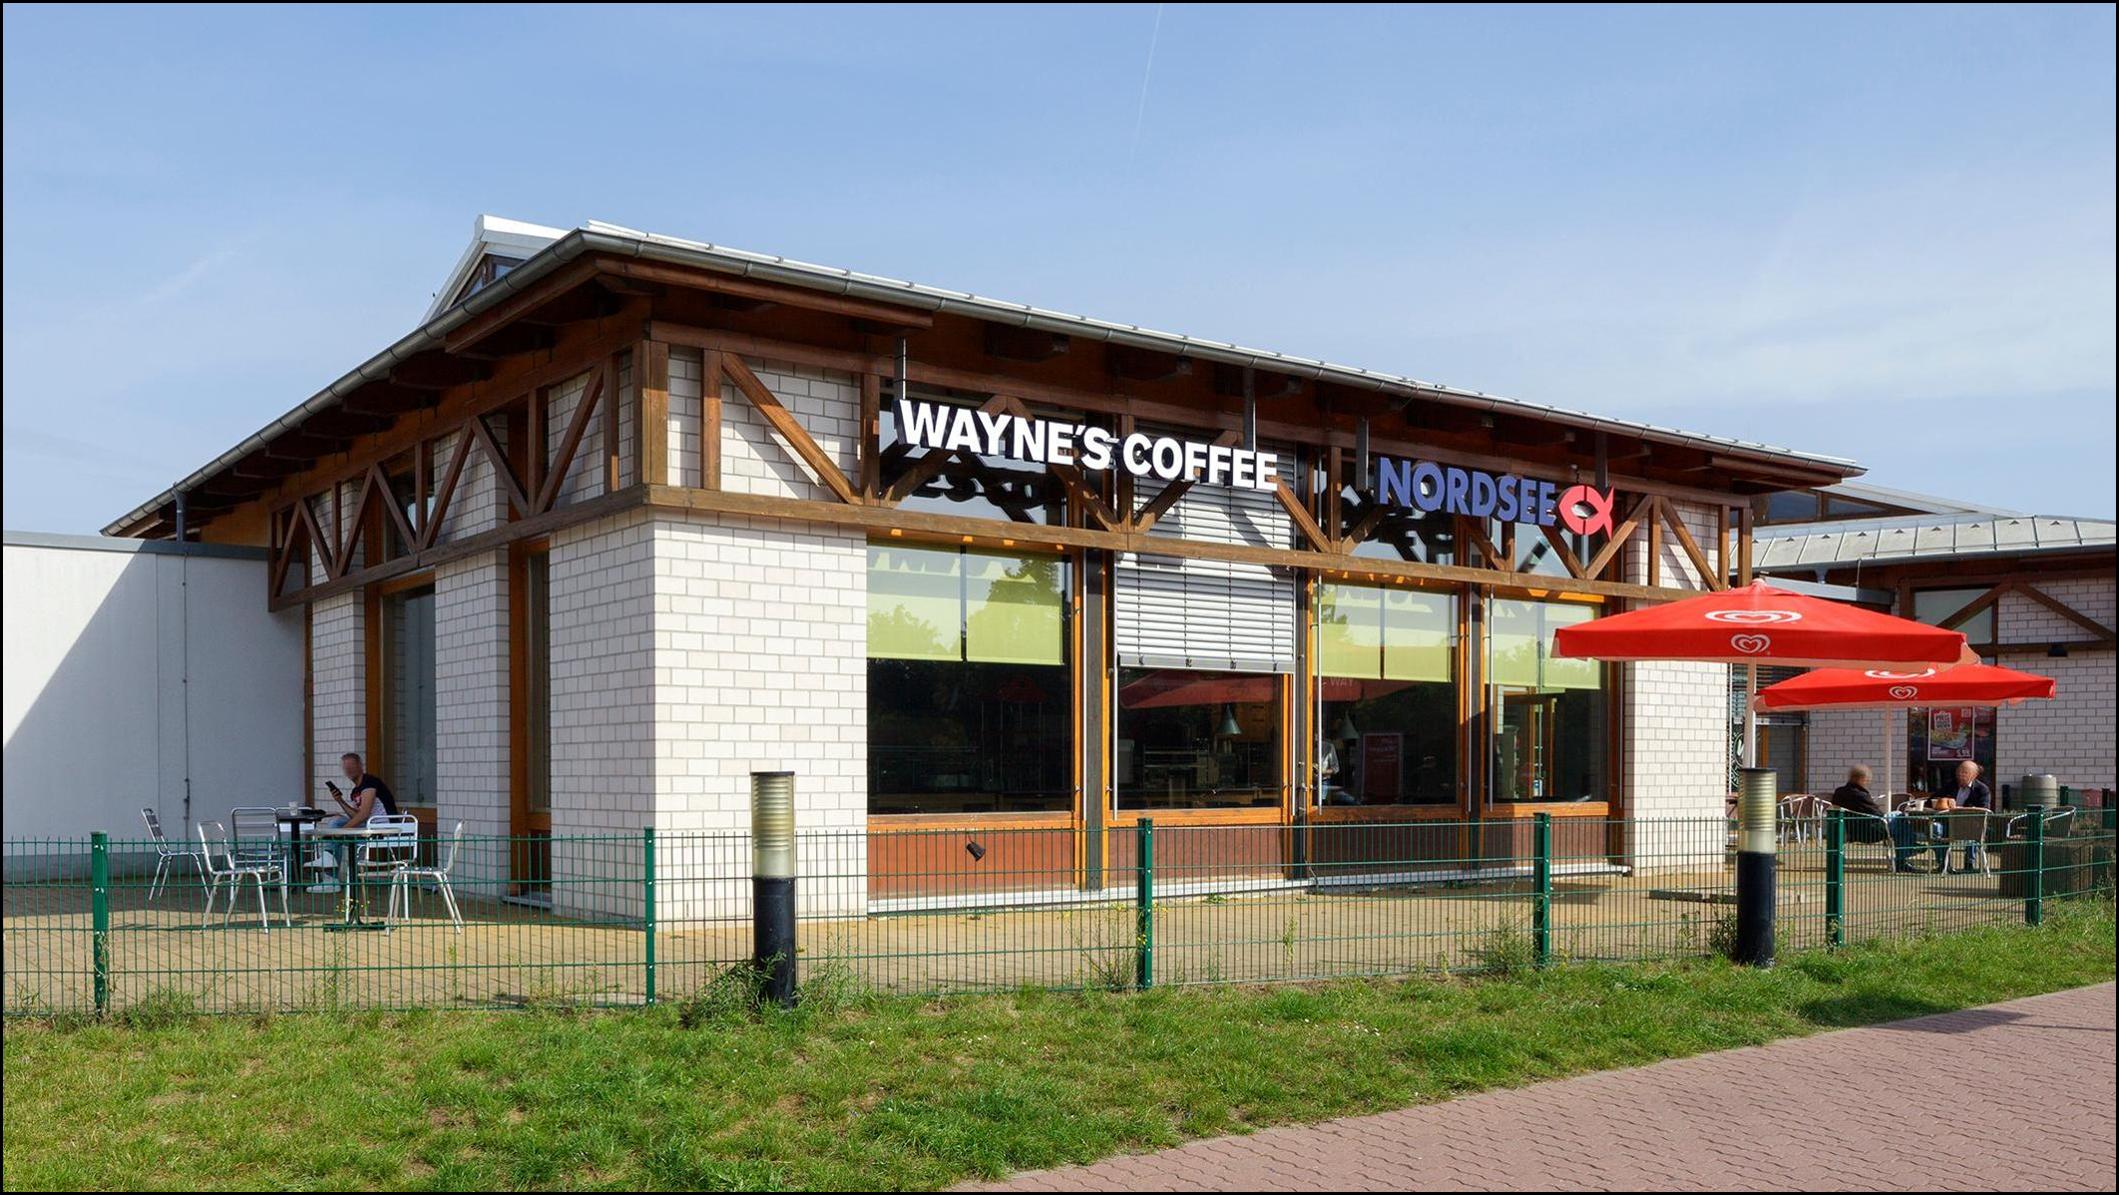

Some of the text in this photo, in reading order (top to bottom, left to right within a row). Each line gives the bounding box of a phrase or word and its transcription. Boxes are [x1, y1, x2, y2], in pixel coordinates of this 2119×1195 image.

[899, 400, 1278, 492] WAYNE'S COFFEE
[1379, 457, 1556, 527] NORDSEE
